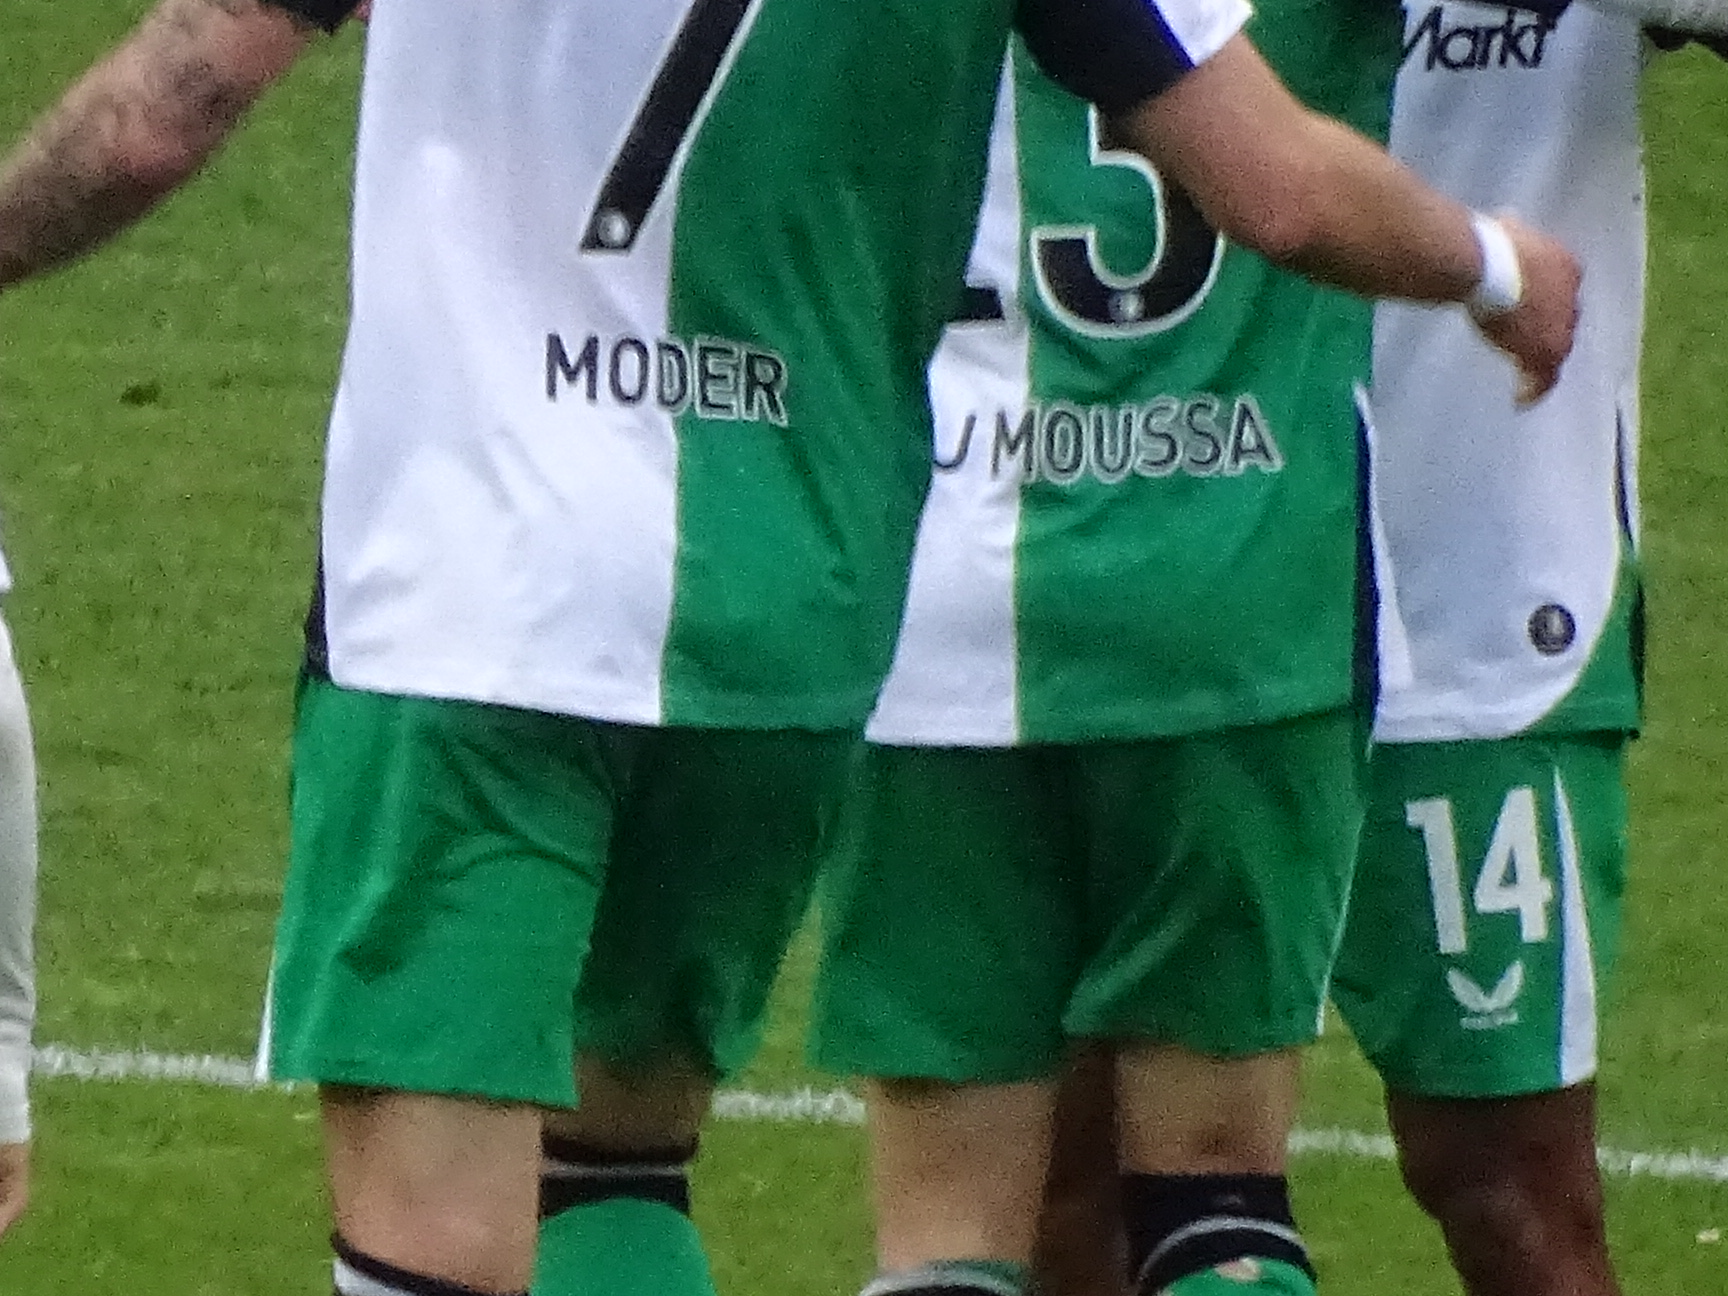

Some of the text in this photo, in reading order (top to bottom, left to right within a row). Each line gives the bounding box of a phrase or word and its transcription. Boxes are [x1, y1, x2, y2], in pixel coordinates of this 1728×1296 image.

[544, 333, 789, 427] MODER
[989, 394, 1284, 484] MOUSSA
[1404, 785, 1553, 955] 14
